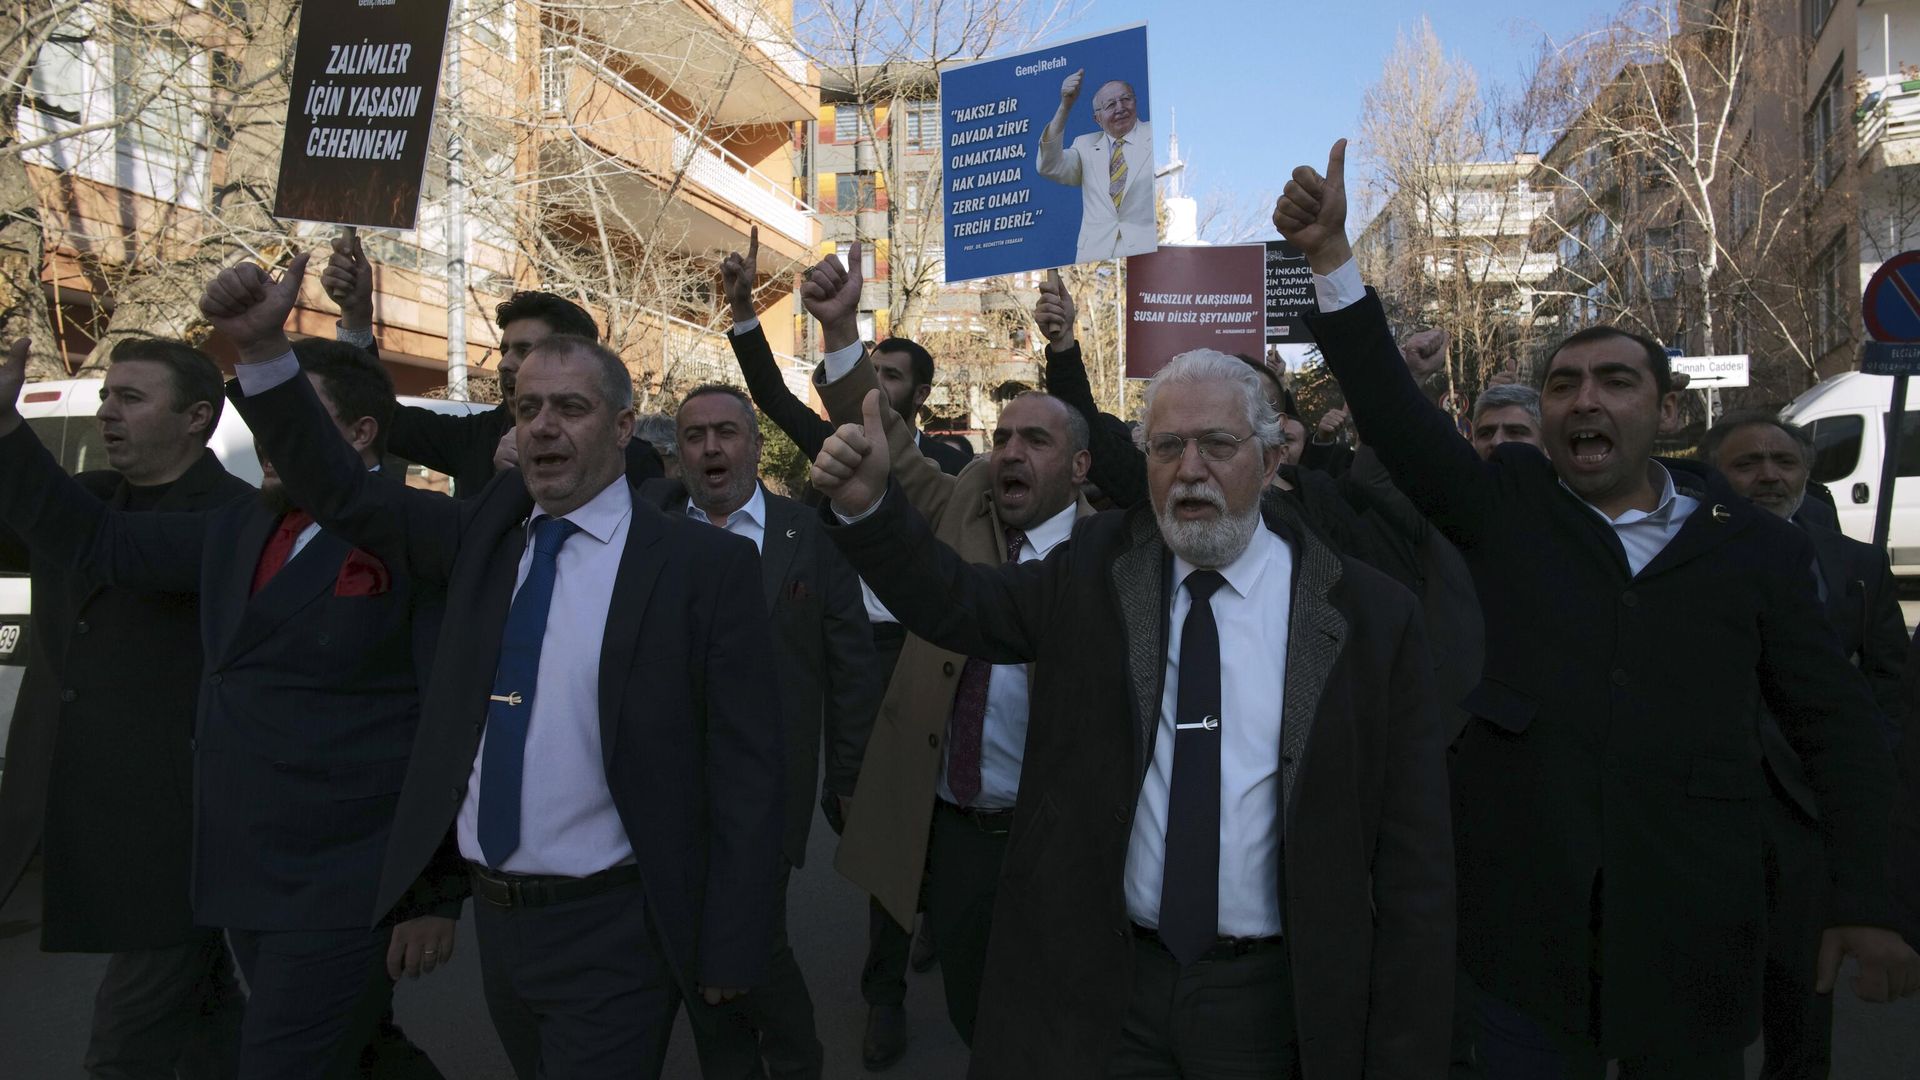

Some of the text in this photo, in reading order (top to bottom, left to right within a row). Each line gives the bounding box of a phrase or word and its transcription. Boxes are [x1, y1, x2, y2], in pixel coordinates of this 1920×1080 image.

[325, 38, 412, 74] ZALİMLER
[304, 80, 422, 125] İÇİN YAŞASIN
[998, 97, 1018, 114] BİR
[306, 127, 408, 160] CEHENNEM!
[951, 118, 1029, 147] DAVADA ZİRVE
[951, 143, 1027, 169] OLMAKTANSA,
[952, 167, 1021, 192] HAK DAVADA
[952, 189, 1030, 215] ZERRE OLMAYI
[953, 219, 990, 237] TERCİH
[1195, 293, 1253, 307] KARŞISINDA
[1279, 298, 1315, 306] TAPMAM
[1133, 310, 1165, 322] SUSAN
[1167, 309, 1197, 323] DİLSİZ
[1708, 361, 1744, 372] Caddesi
